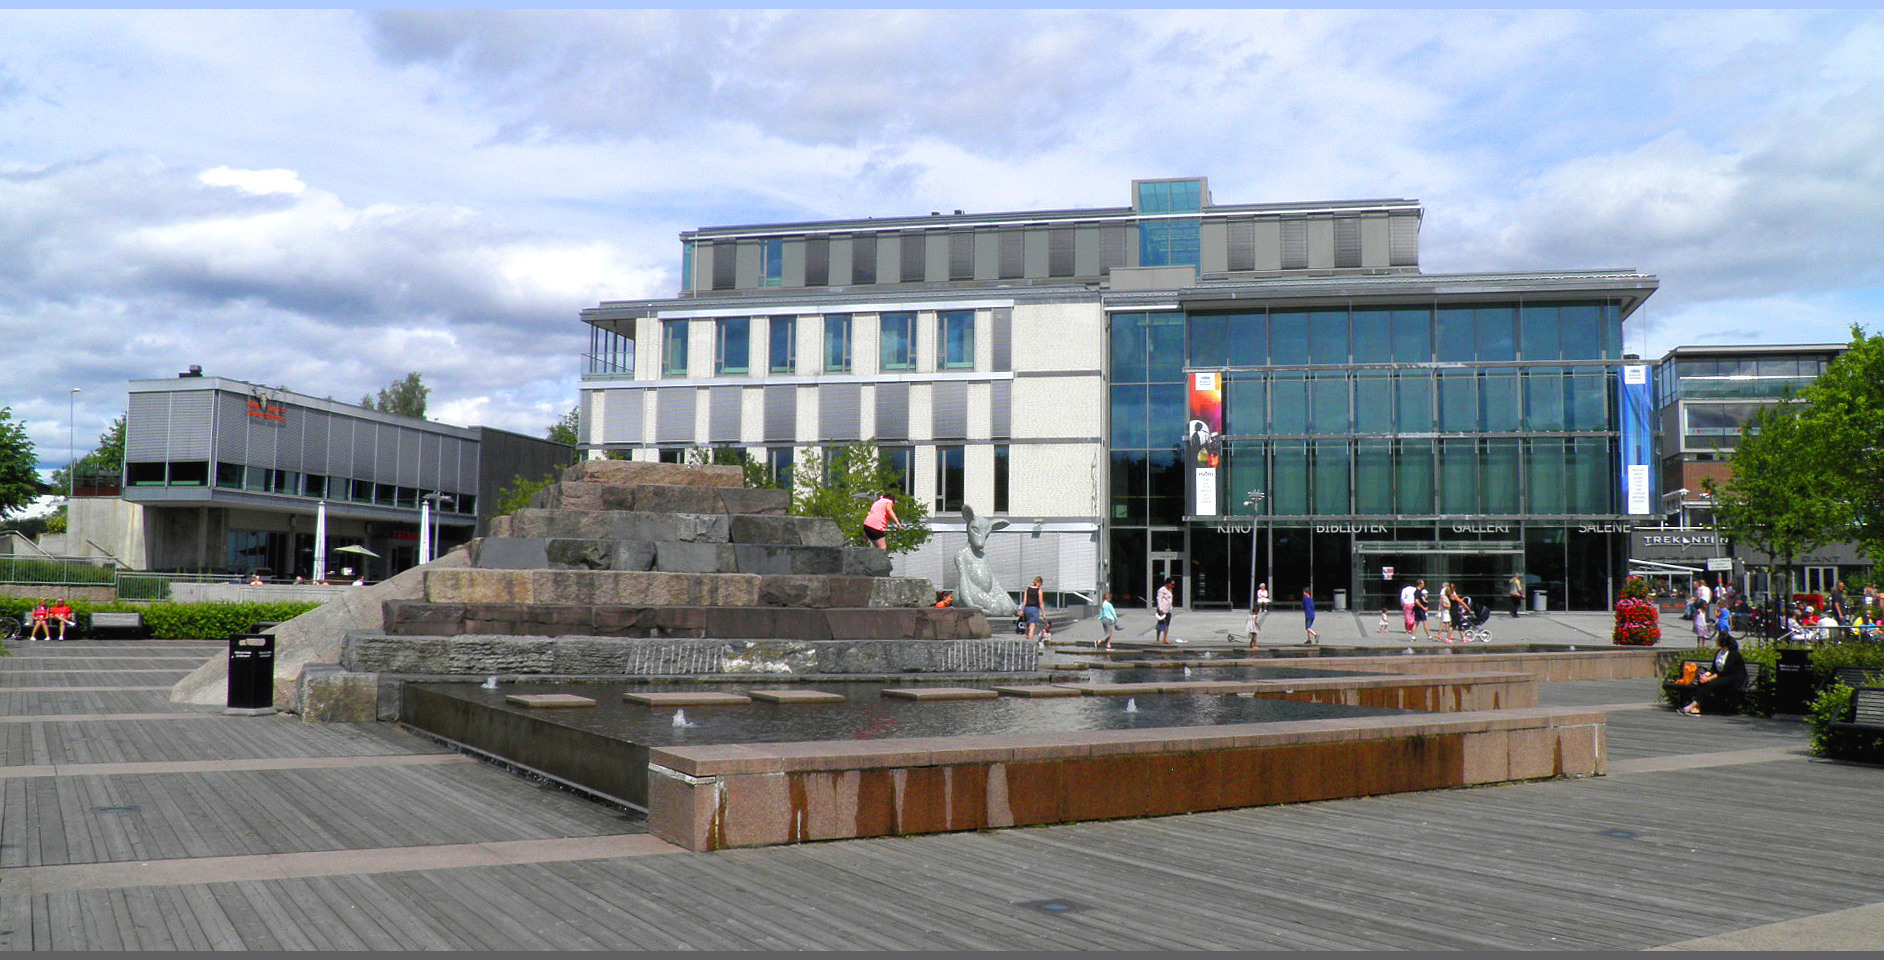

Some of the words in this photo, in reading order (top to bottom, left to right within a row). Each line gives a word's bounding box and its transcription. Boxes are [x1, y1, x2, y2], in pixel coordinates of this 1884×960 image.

[1217, 522, 1251, 534] KINO
[1316, 522, 1388, 533] BIBLIOTEK
[1452, 522, 1510, 533] GALLERI
[1578, 522, 1631, 533] SALENE
